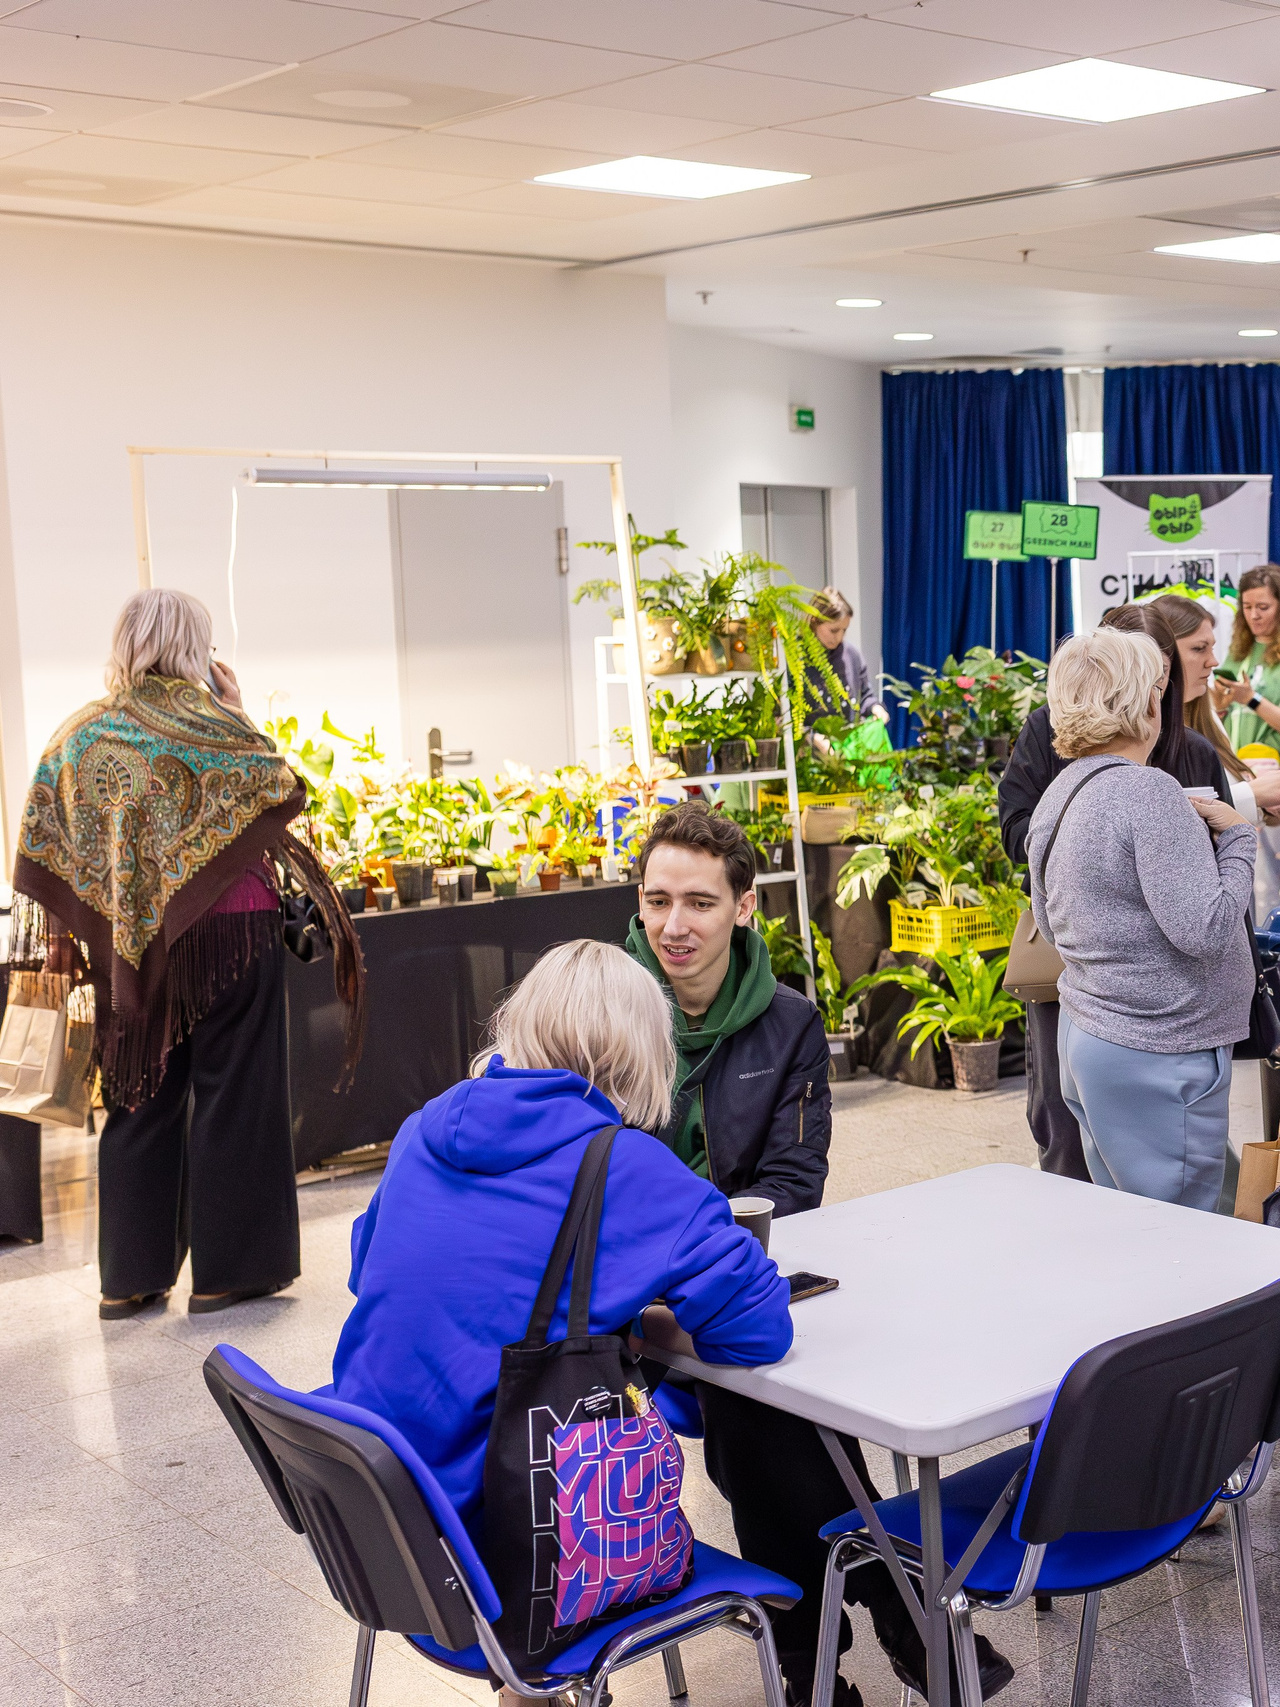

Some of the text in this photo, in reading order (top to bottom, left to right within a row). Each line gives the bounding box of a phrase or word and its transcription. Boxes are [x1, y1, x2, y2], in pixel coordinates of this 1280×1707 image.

[1050, 513, 1068, 526] 28
[1153, 506, 1187, 520] ФЫР
[990, 522, 1004, 532] 27
[1157, 522, 1194, 535] ФЫР
